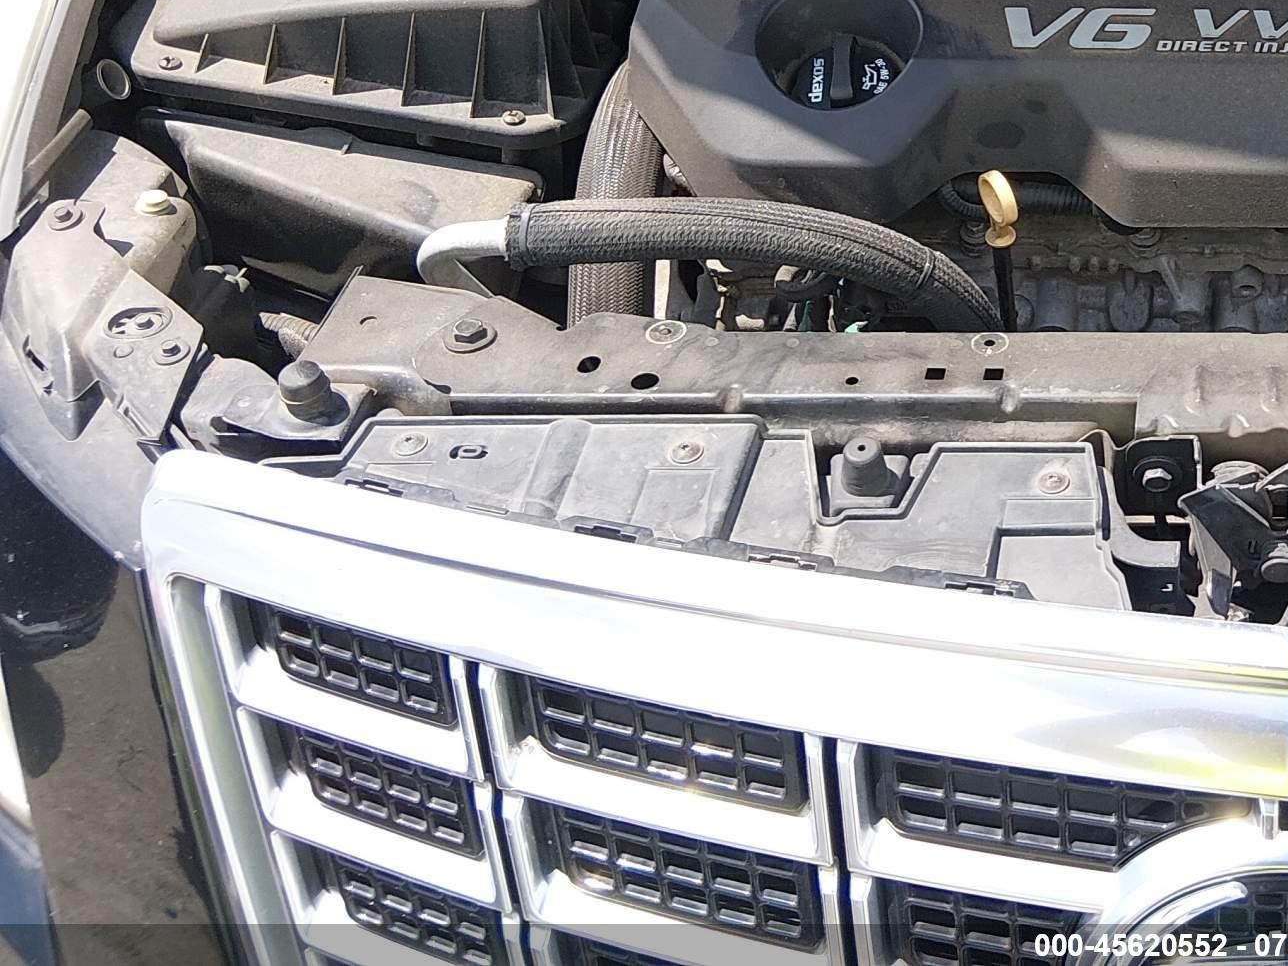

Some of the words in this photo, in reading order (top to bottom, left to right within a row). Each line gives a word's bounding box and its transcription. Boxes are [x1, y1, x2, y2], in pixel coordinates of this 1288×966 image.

[1004, 7, 1156, 50] V6
[1156, 40, 1247, 52] DIRECT
[808, 57, 825, 103] dexos
